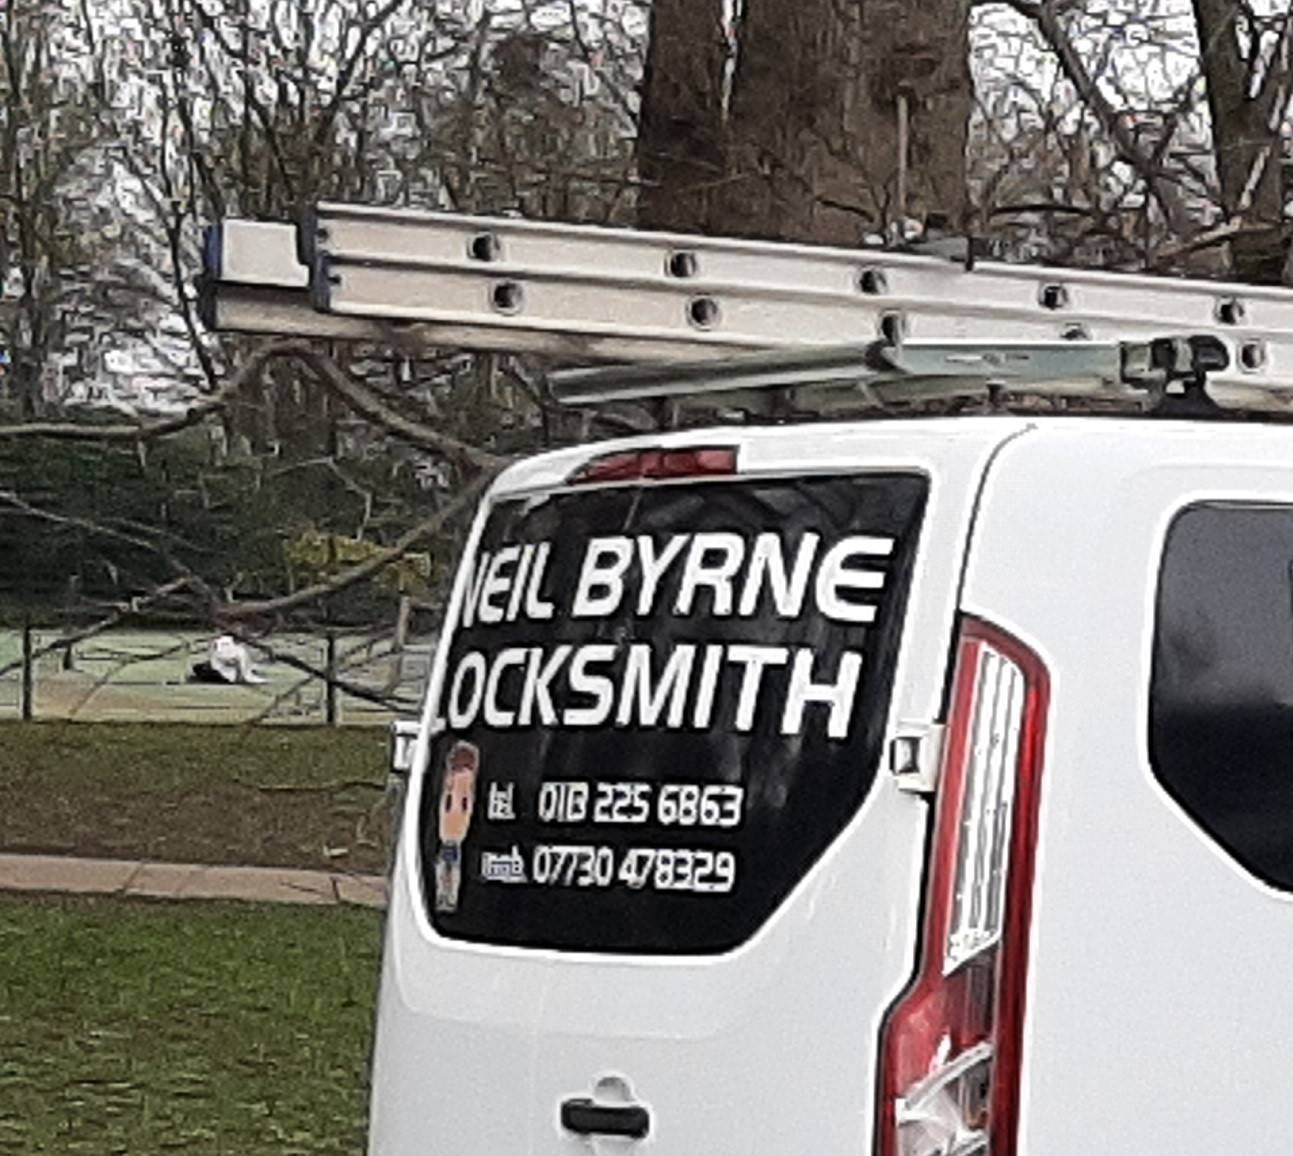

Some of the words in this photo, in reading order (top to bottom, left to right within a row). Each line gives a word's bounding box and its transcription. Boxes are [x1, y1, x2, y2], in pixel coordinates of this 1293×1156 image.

[572, 532, 895, 623] BYRNE
[594, 782, 652, 823] 225
[657, 784, 745, 827] 6863
[533, 845, 614, 887] 07730
[618, 848, 736, 892] 478329
